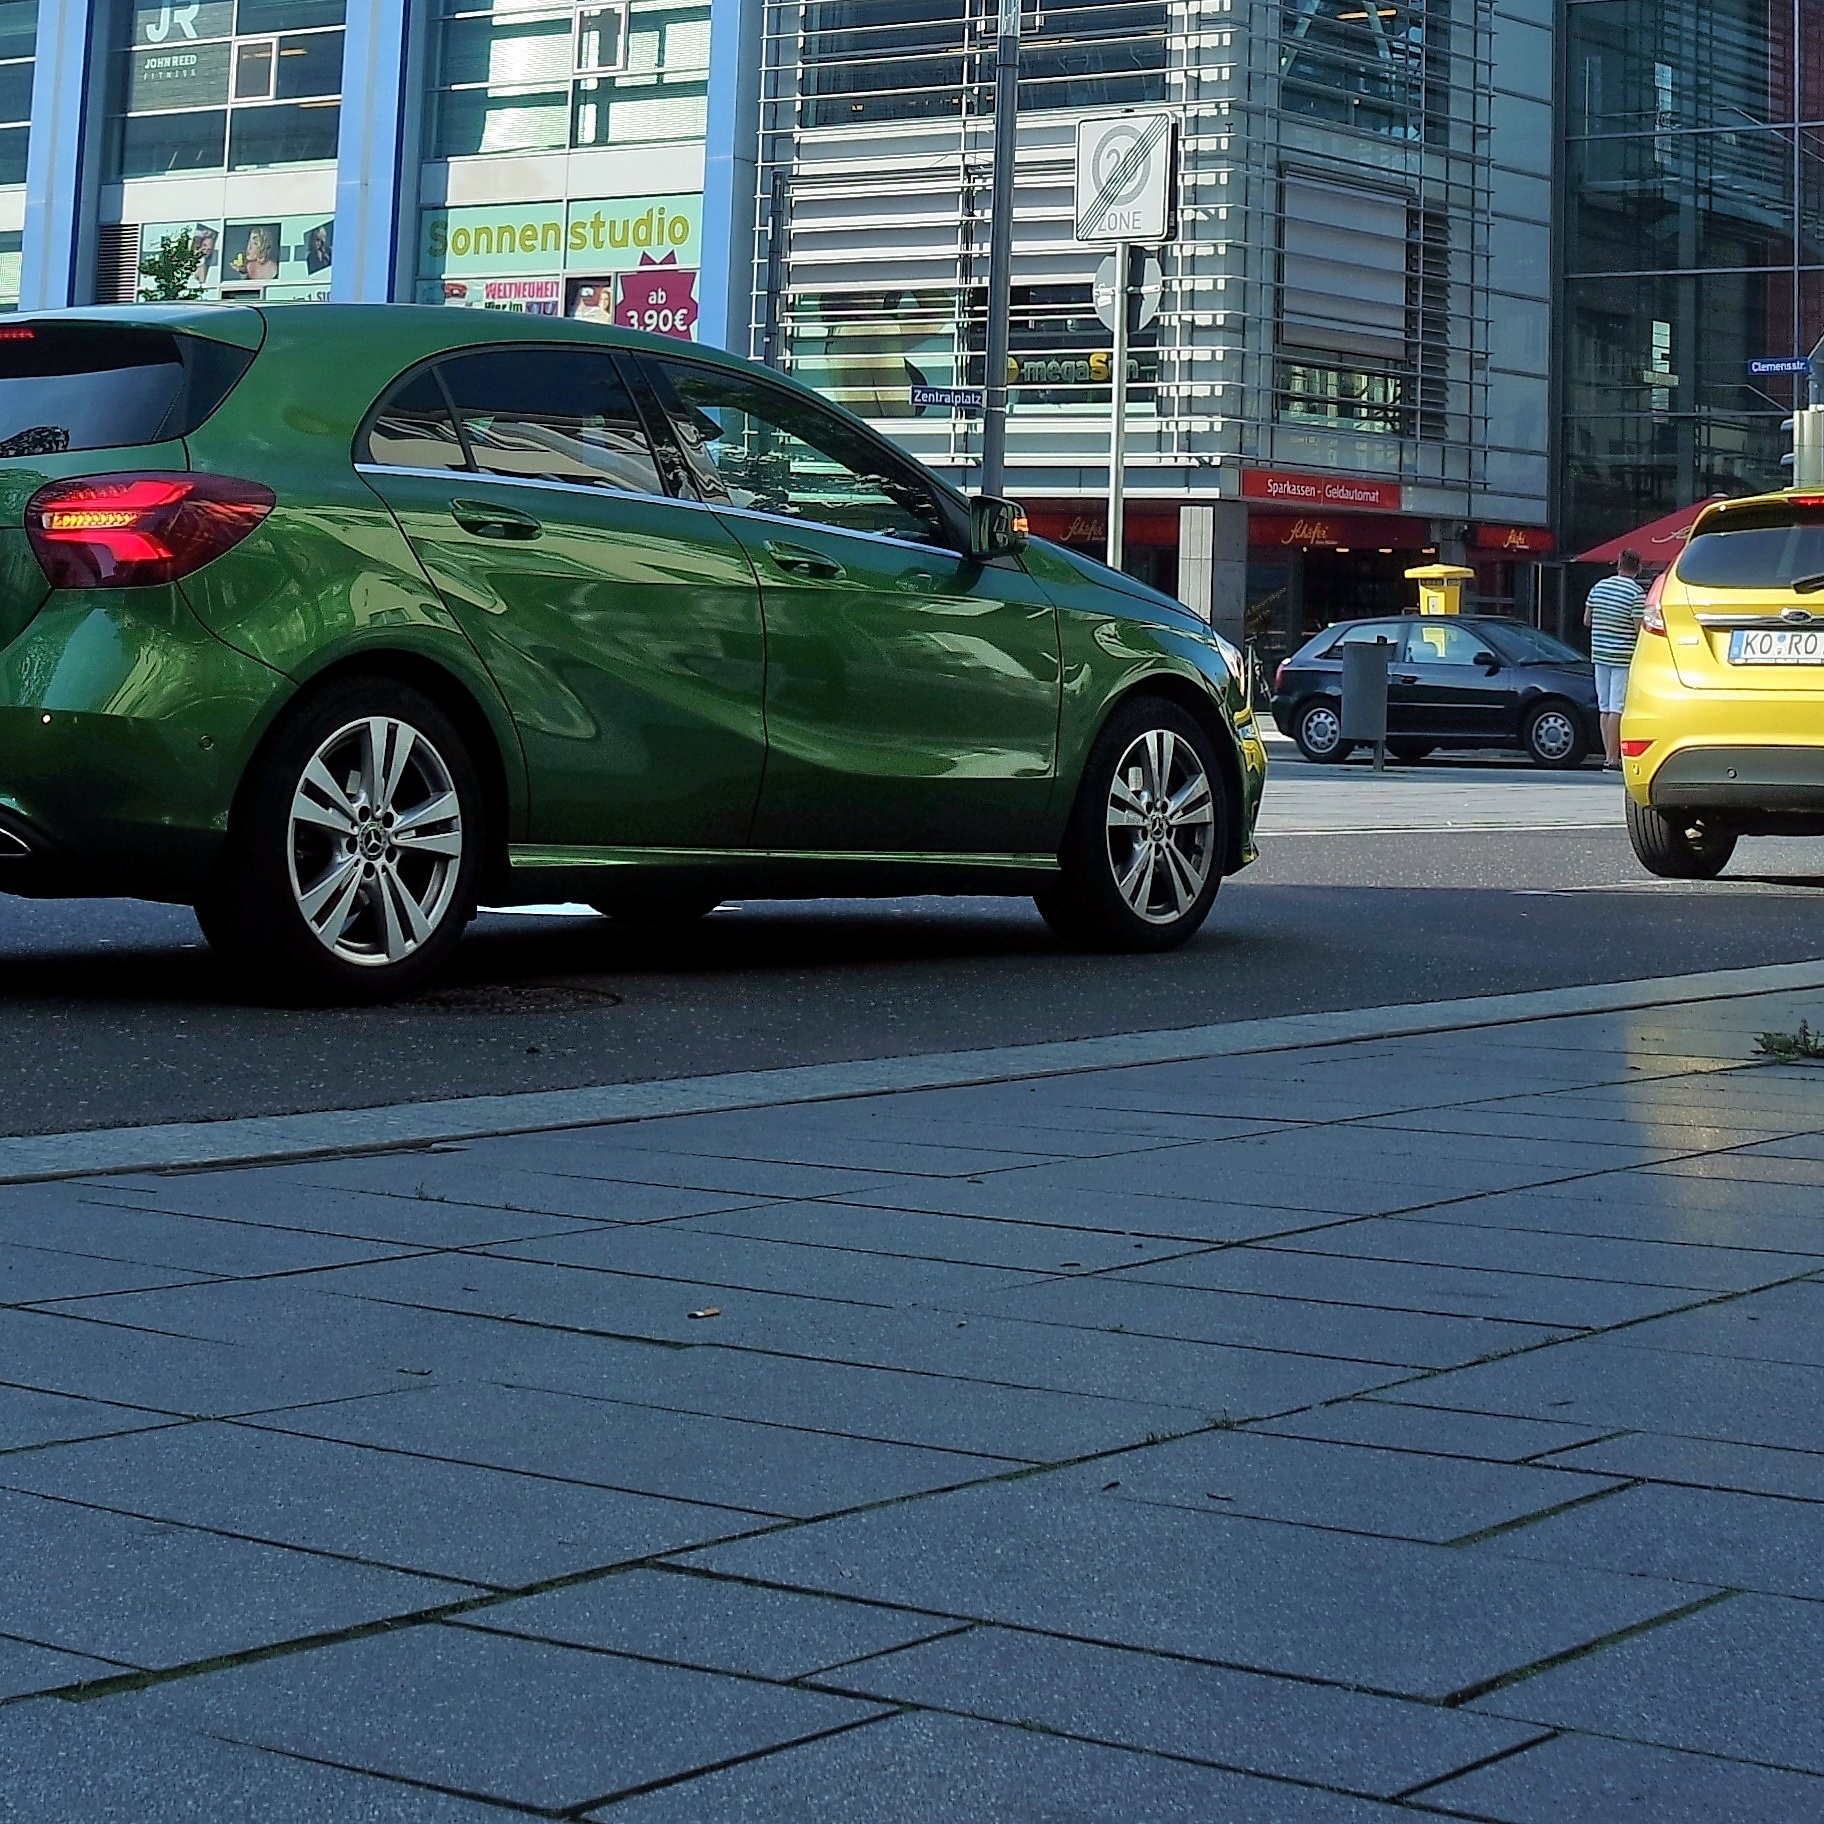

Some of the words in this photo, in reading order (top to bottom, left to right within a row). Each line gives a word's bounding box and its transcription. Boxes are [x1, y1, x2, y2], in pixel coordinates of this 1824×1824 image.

[144, 56, 171, 69] JOHN
[172, 54, 197, 67] REED
[1096, 209, 1142, 232] ZONE
[427, 207, 690, 258] Sonnenstudio
[485, 280, 559, 299] WELTNEUHEIT
[647, 286, 667, 306] ab
[1023, 352, 1139, 383] megaSn
[1751, 361, 1807, 373] Clemensstr.
[913, 389, 982, 405] Zentralplatz
[1267, 478, 1316, 497] Sparkassen
[1325, 483, 1380, 504] Geldautomat
[1743, 633, 1773, 655] KO
[1787, 633, 1818, 655] RO
